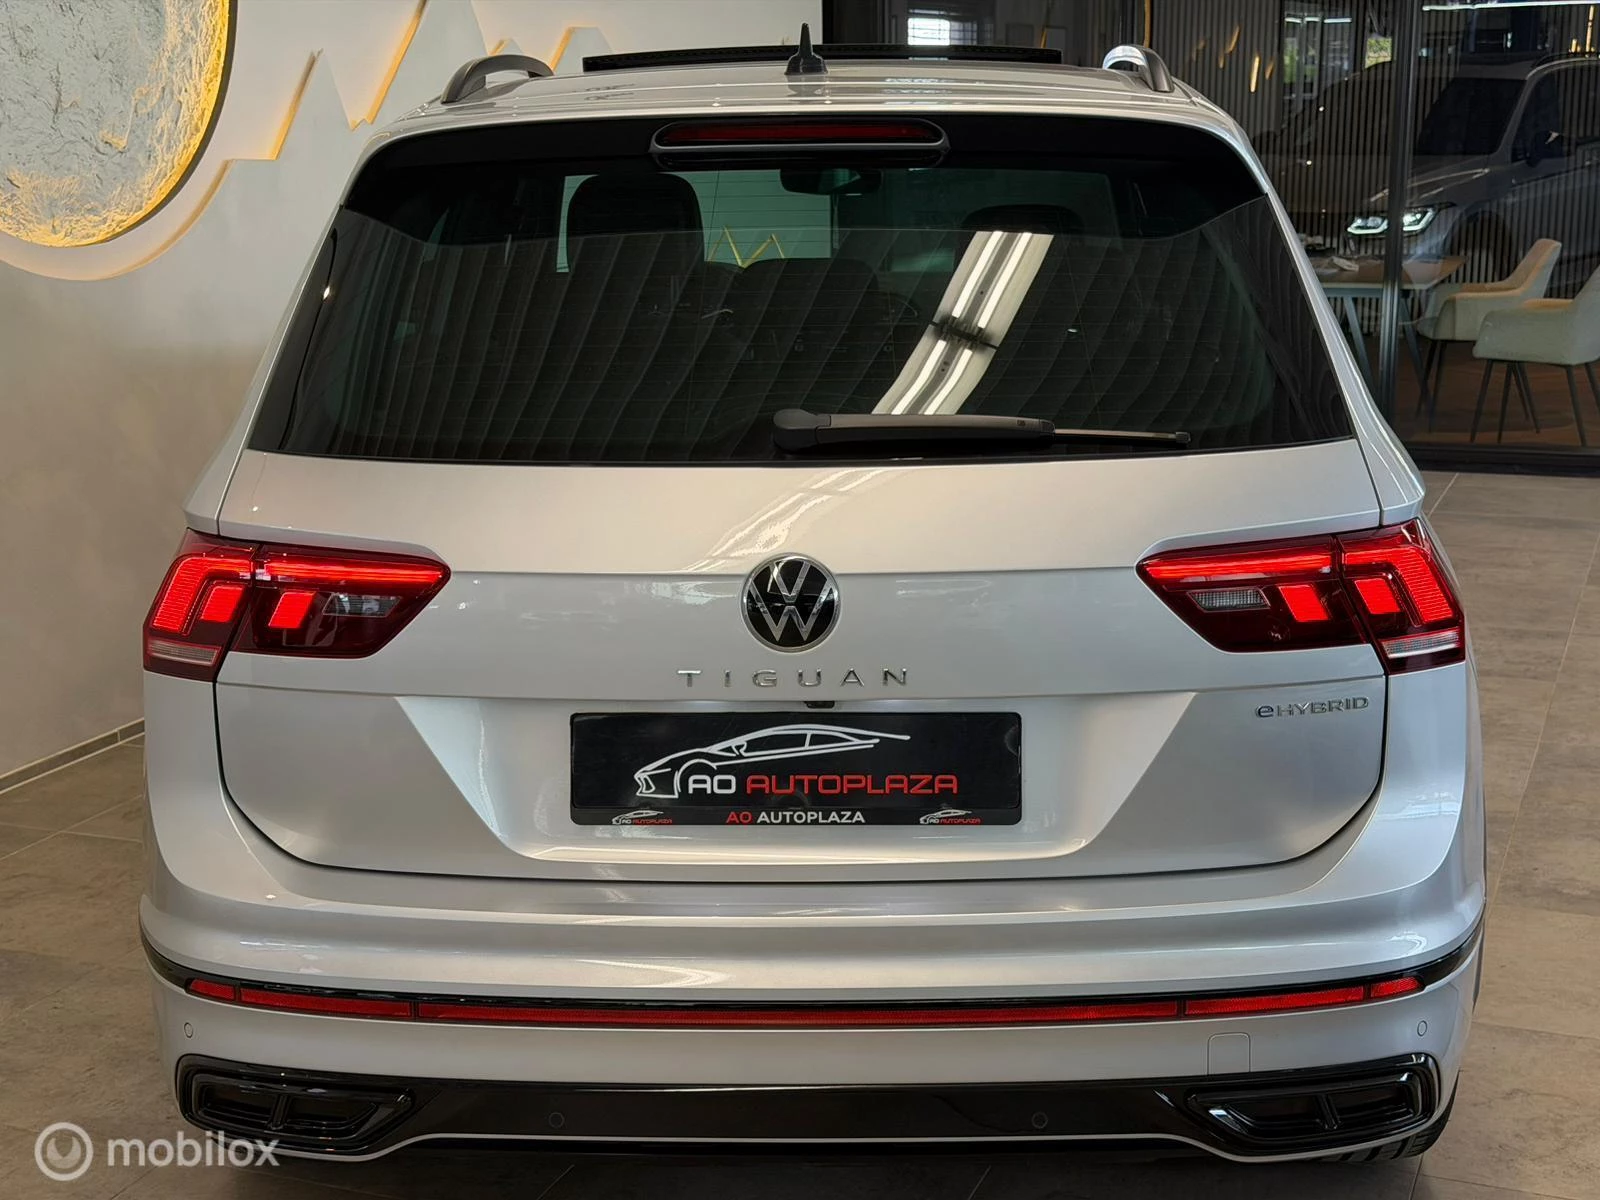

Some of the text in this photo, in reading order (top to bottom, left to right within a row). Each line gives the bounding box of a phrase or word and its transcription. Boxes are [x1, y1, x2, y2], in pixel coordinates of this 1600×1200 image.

[677, 668, 908, 688] TIGUAN
[1256, 697, 1369, 718] eHYBRID
[688, 775, 958, 794] AO AUTOPLAZA
[726, 811, 865, 824] AO AUTOPLAZA
